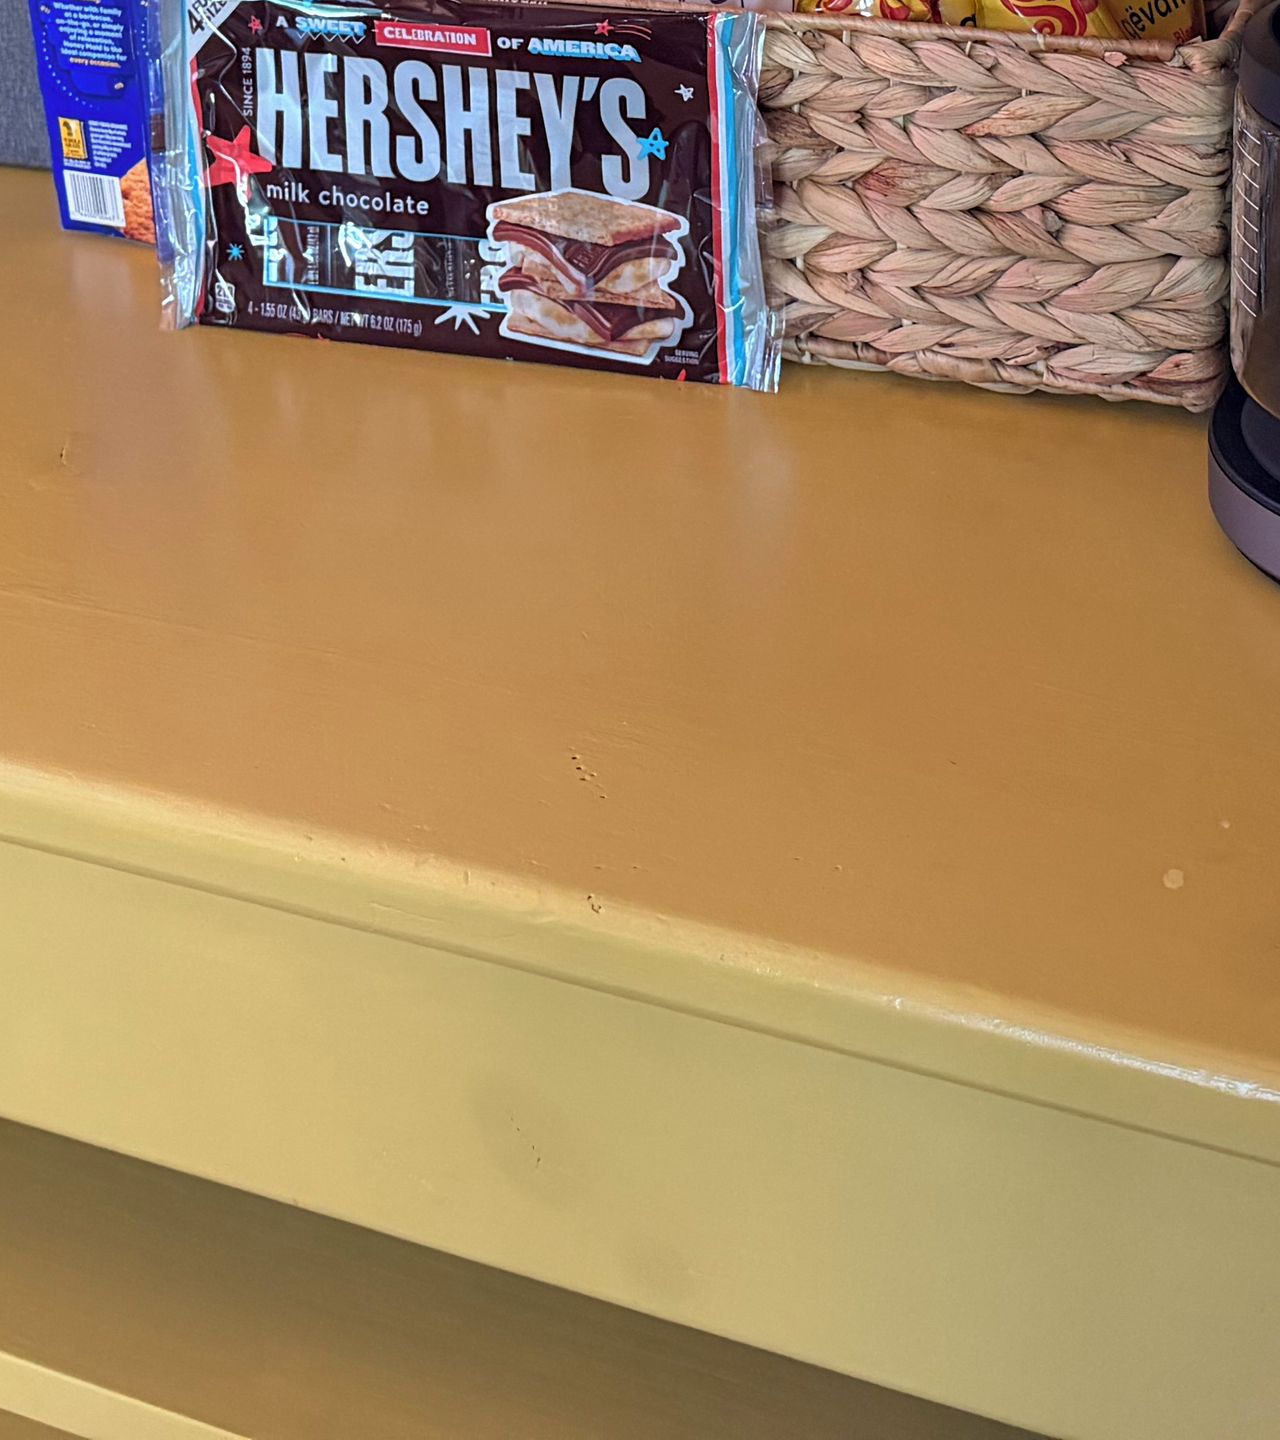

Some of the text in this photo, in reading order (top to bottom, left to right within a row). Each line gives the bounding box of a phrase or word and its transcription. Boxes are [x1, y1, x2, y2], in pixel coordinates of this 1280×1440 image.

[188, 9, 205, 34] 4
[276, 16, 641, 63] A SWEET CELEBRATION OF AMERICA
[241, 46, 254, 117] SINCE 1894
[256, 47, 651, 200] HERSHEY'S
[267, 182, 430, 216] milk chocolate
[248, 300, 253, 313] 4
[261, 302, 276, 317] 1.55
[277, 304, 288, 319] OZ
[313, 308, 333, 325] BARS
[370, 314, 383, 330] 6.2
[384, 316, 394, 331] OZ
[395, 318, 412, 334] (175
[413, 321, 423, 337] g)
